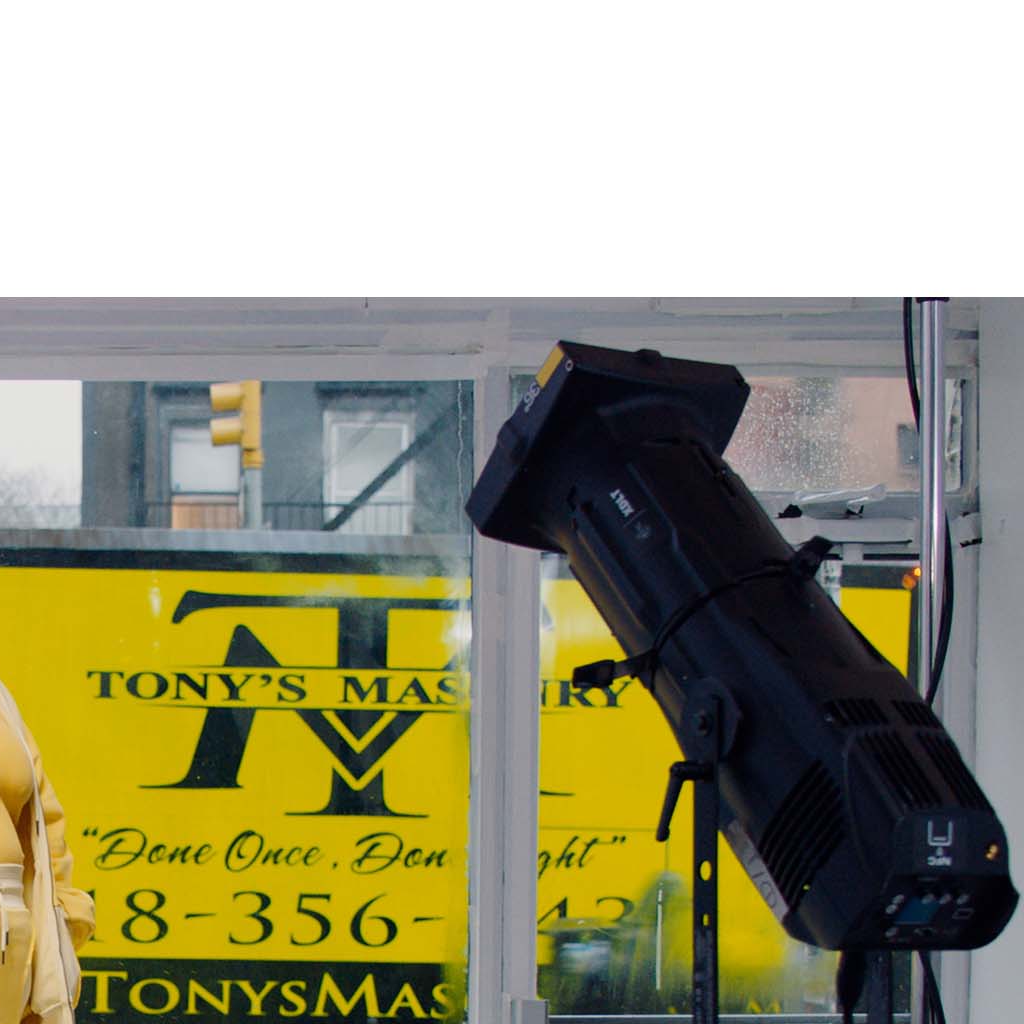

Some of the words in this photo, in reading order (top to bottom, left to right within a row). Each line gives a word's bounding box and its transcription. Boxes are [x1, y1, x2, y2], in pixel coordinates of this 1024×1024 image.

[87, 670, 307, 704] TONY'S
[338, 675, 632, 708] MASRY
[224, 829, 324, 874] Once
[351, 832, 449, 875] Don
